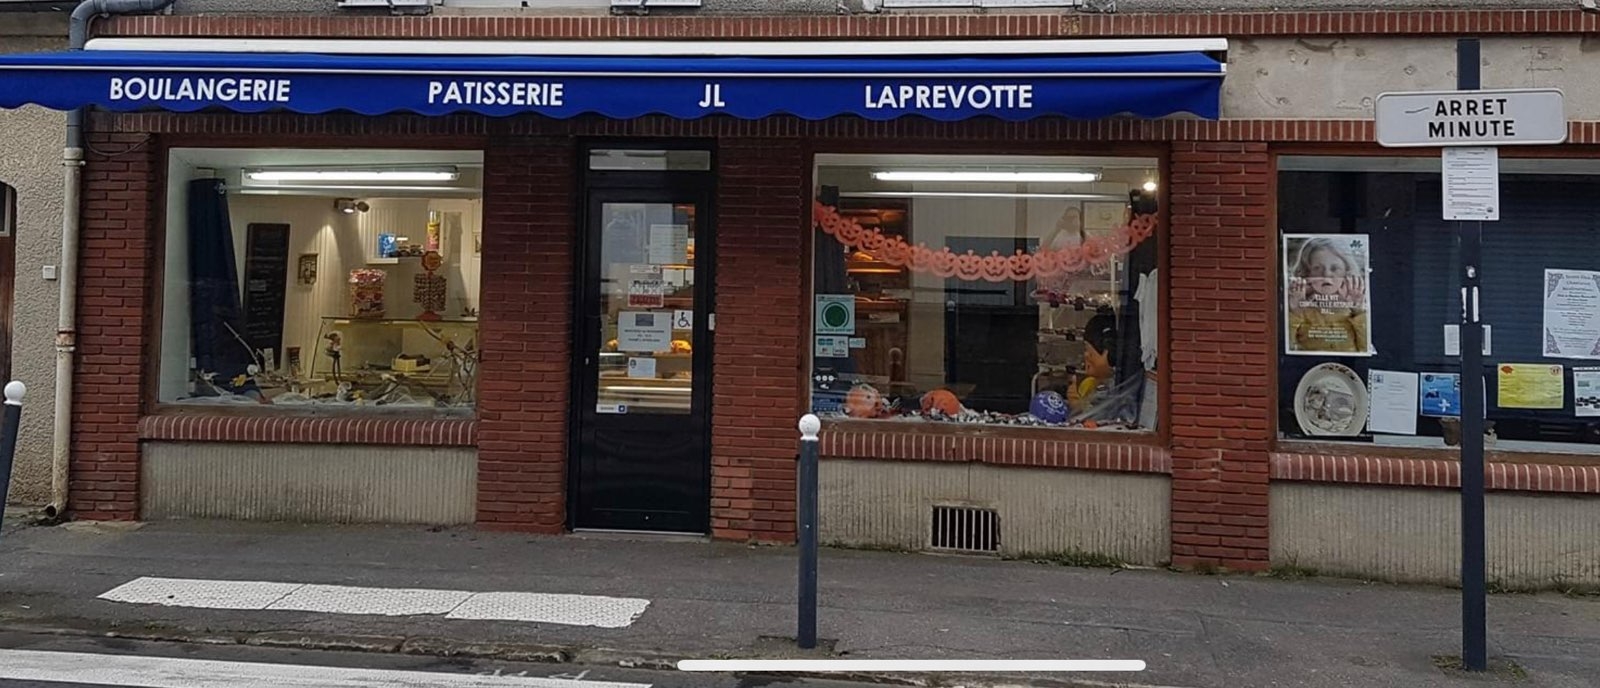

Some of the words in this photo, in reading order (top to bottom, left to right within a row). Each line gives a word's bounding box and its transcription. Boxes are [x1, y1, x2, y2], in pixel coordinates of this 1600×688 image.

[110, 78, 291, 102] BOULANGERIE
[428, 82, 563, 106] PATISSERIE
[698, 85, 725, 108] JL
[866, 85, 1033, 109] LAPREVOTTE
[1434, 97, 1508, 117] ARRET
[1428, 119, 1516, 138] MINUTE
